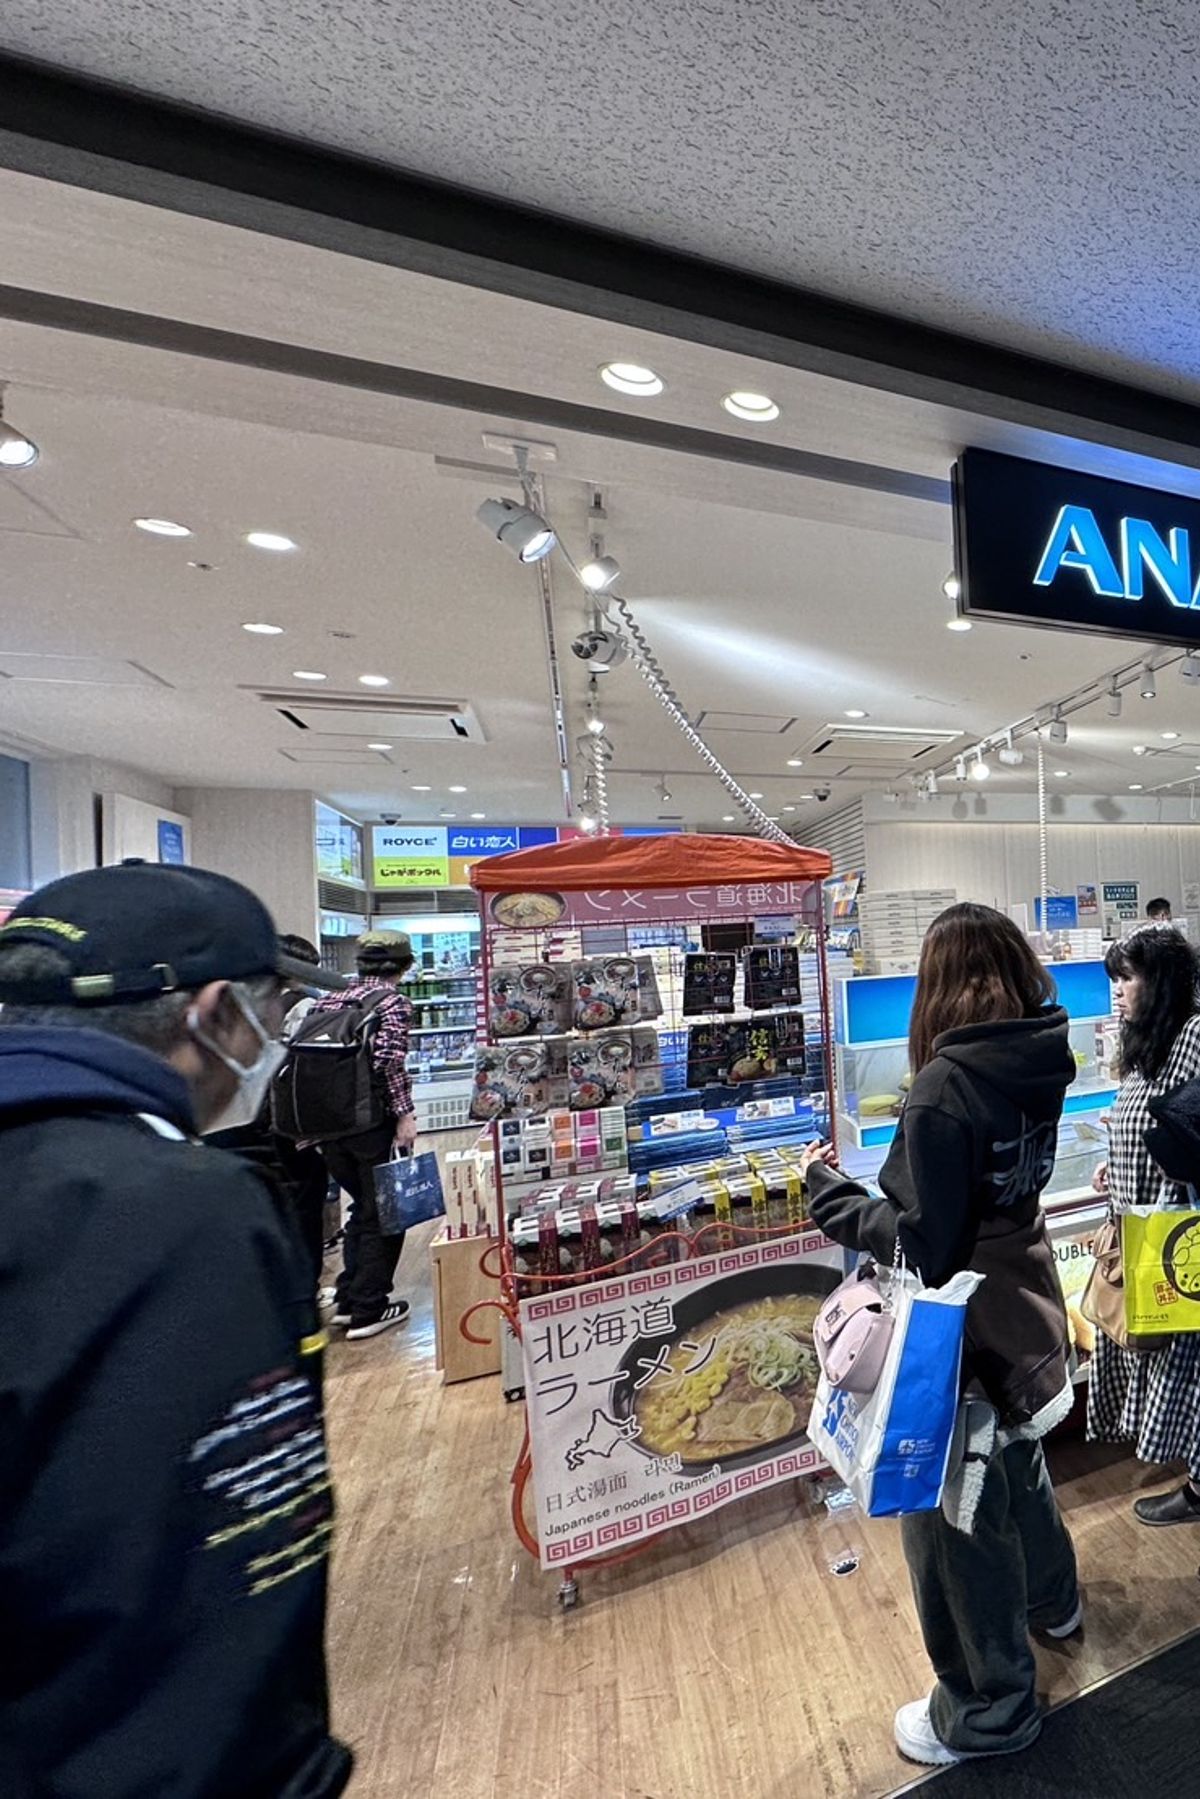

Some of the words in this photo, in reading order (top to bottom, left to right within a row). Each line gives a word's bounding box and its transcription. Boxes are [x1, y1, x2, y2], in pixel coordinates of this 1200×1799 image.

[451, 835, 516, 848] 白い恋人
[532, 1295, 676, 1364] 北海道
[536, 1336, 717, 1416] ラーメン
[545, 1508, 611, 1537] Japanese
[614, 1489, 666, 1514] noodles
[668, 1464, 722, 1496] (Ramen)
